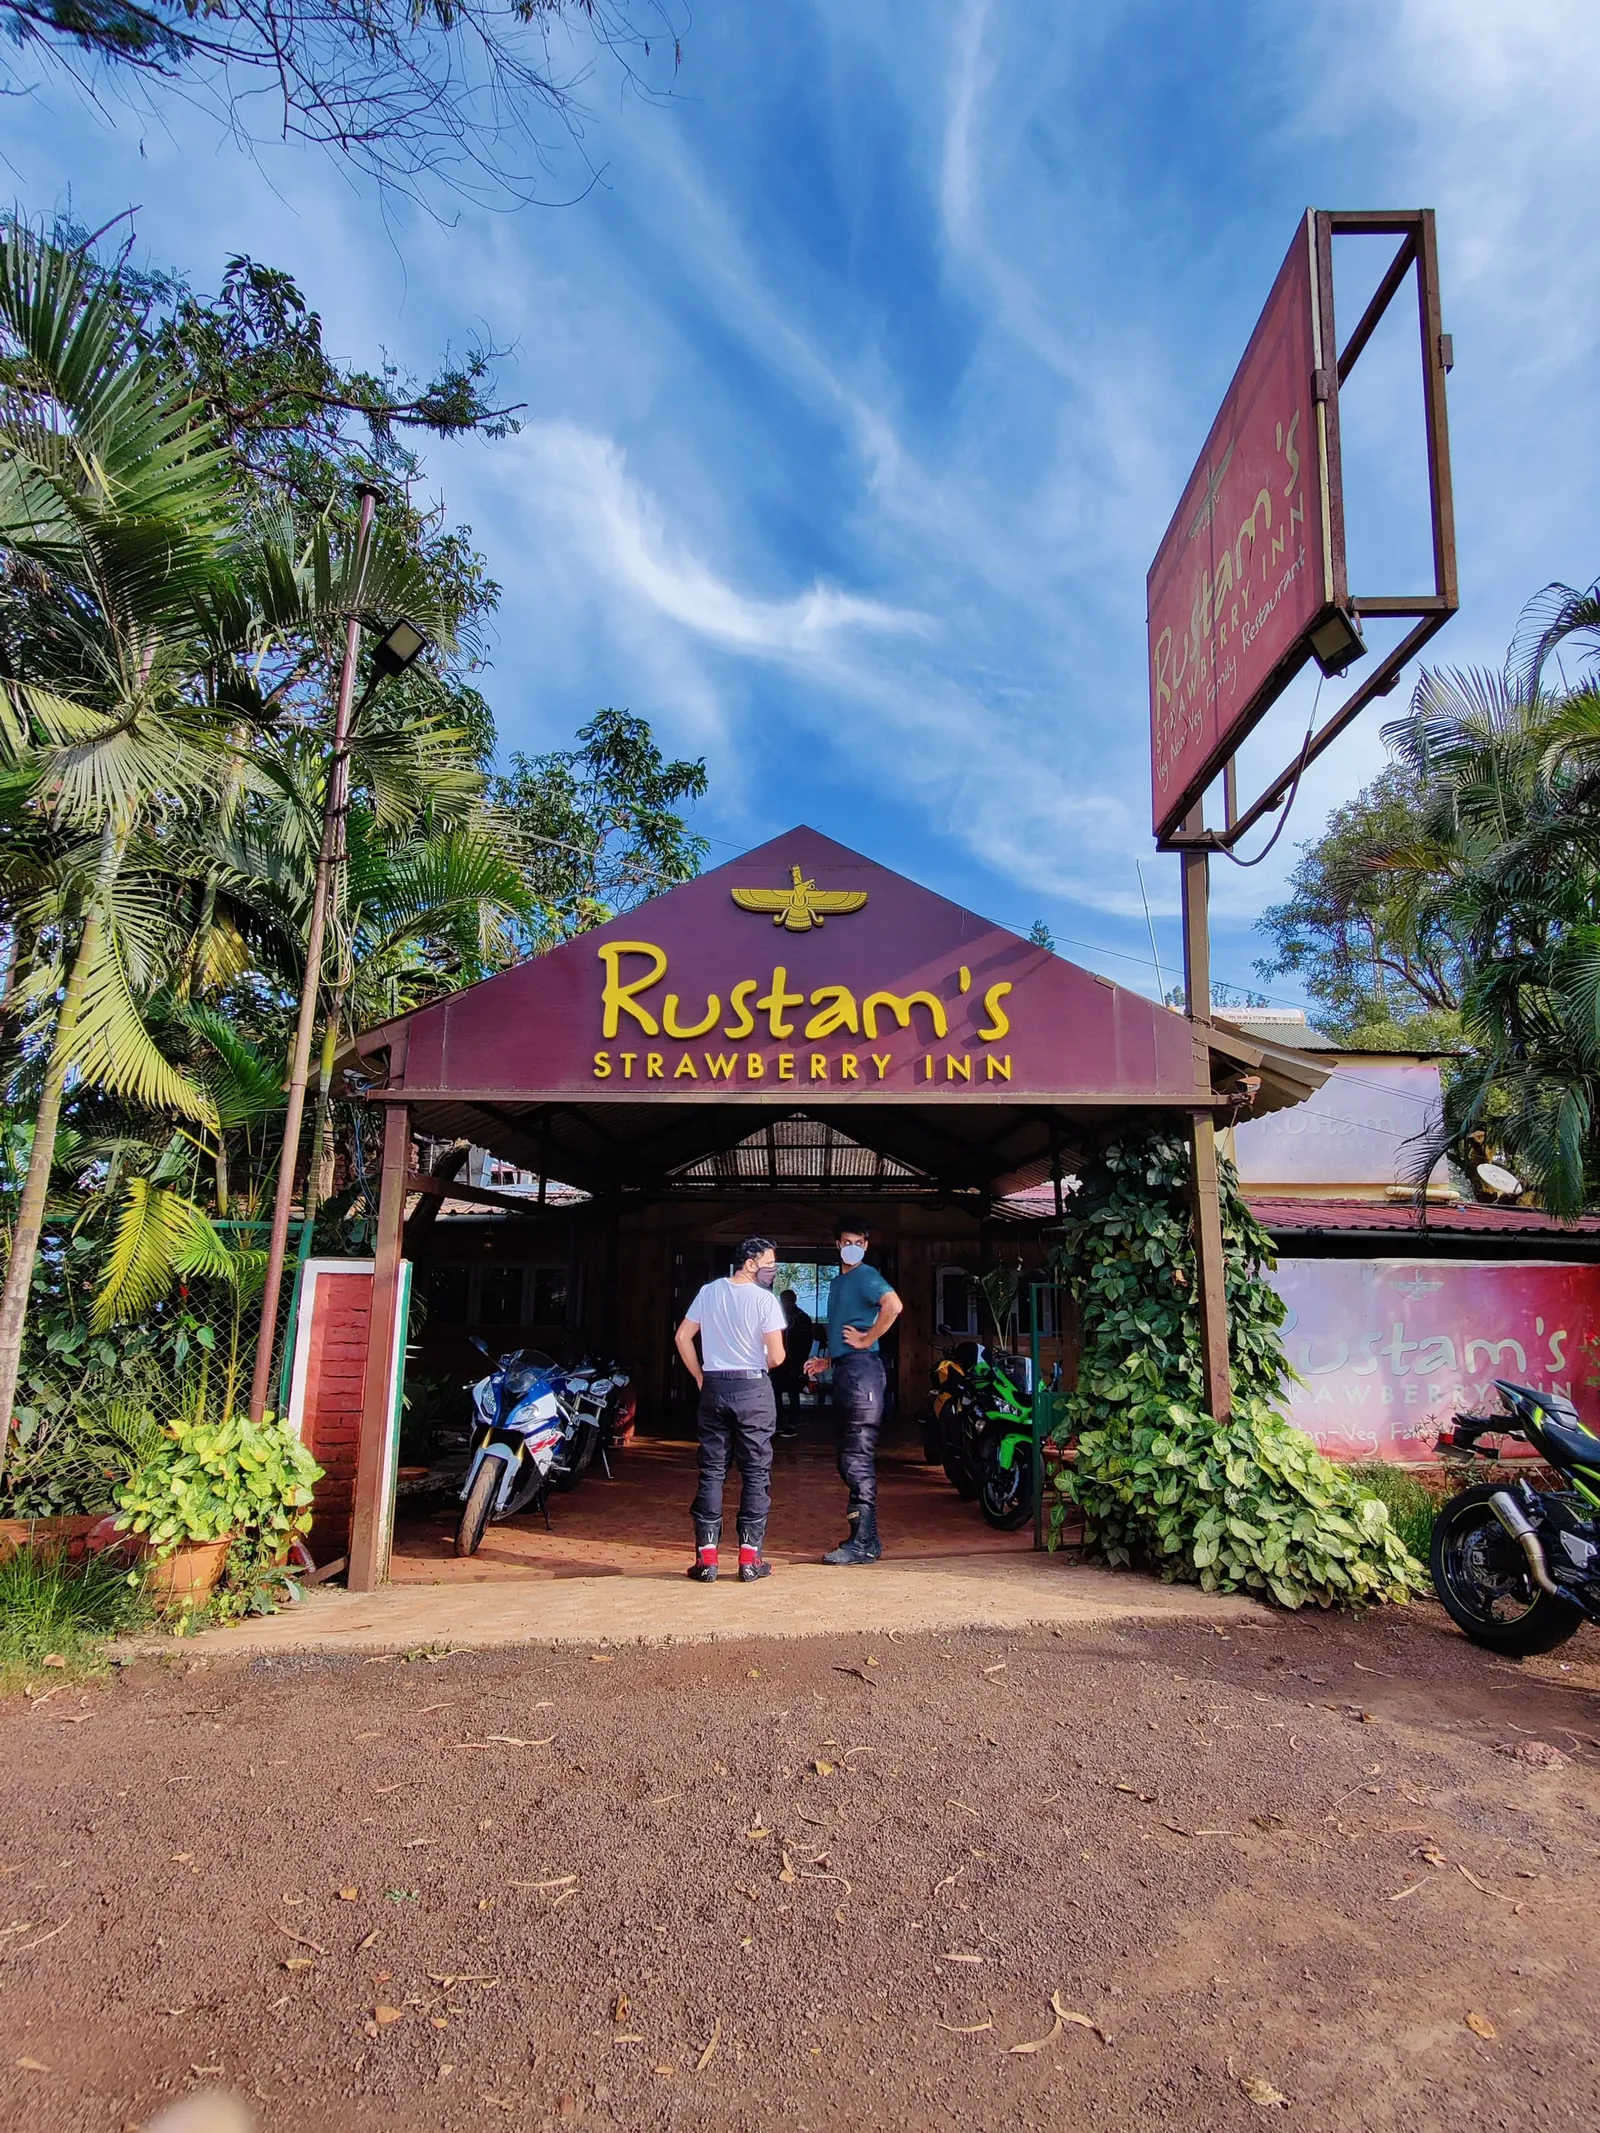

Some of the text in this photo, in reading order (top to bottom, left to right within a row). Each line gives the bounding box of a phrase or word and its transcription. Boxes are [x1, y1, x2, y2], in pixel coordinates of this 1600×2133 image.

[1153, 409, 1300, 723] Rustam's
[1262, 490, 1304, 583] INN
[1156, 747, 1170, 794] Veg
[1205, 655, 1237, 709] Family
[1240, 543, 1306, 655] Restaurant
[598, 941, 1012, 1041] Rustam's
[593, 1051, 1012, 1080] STRAWBERRY INN
[1279, 1308, 1568, 1376] ustam's
